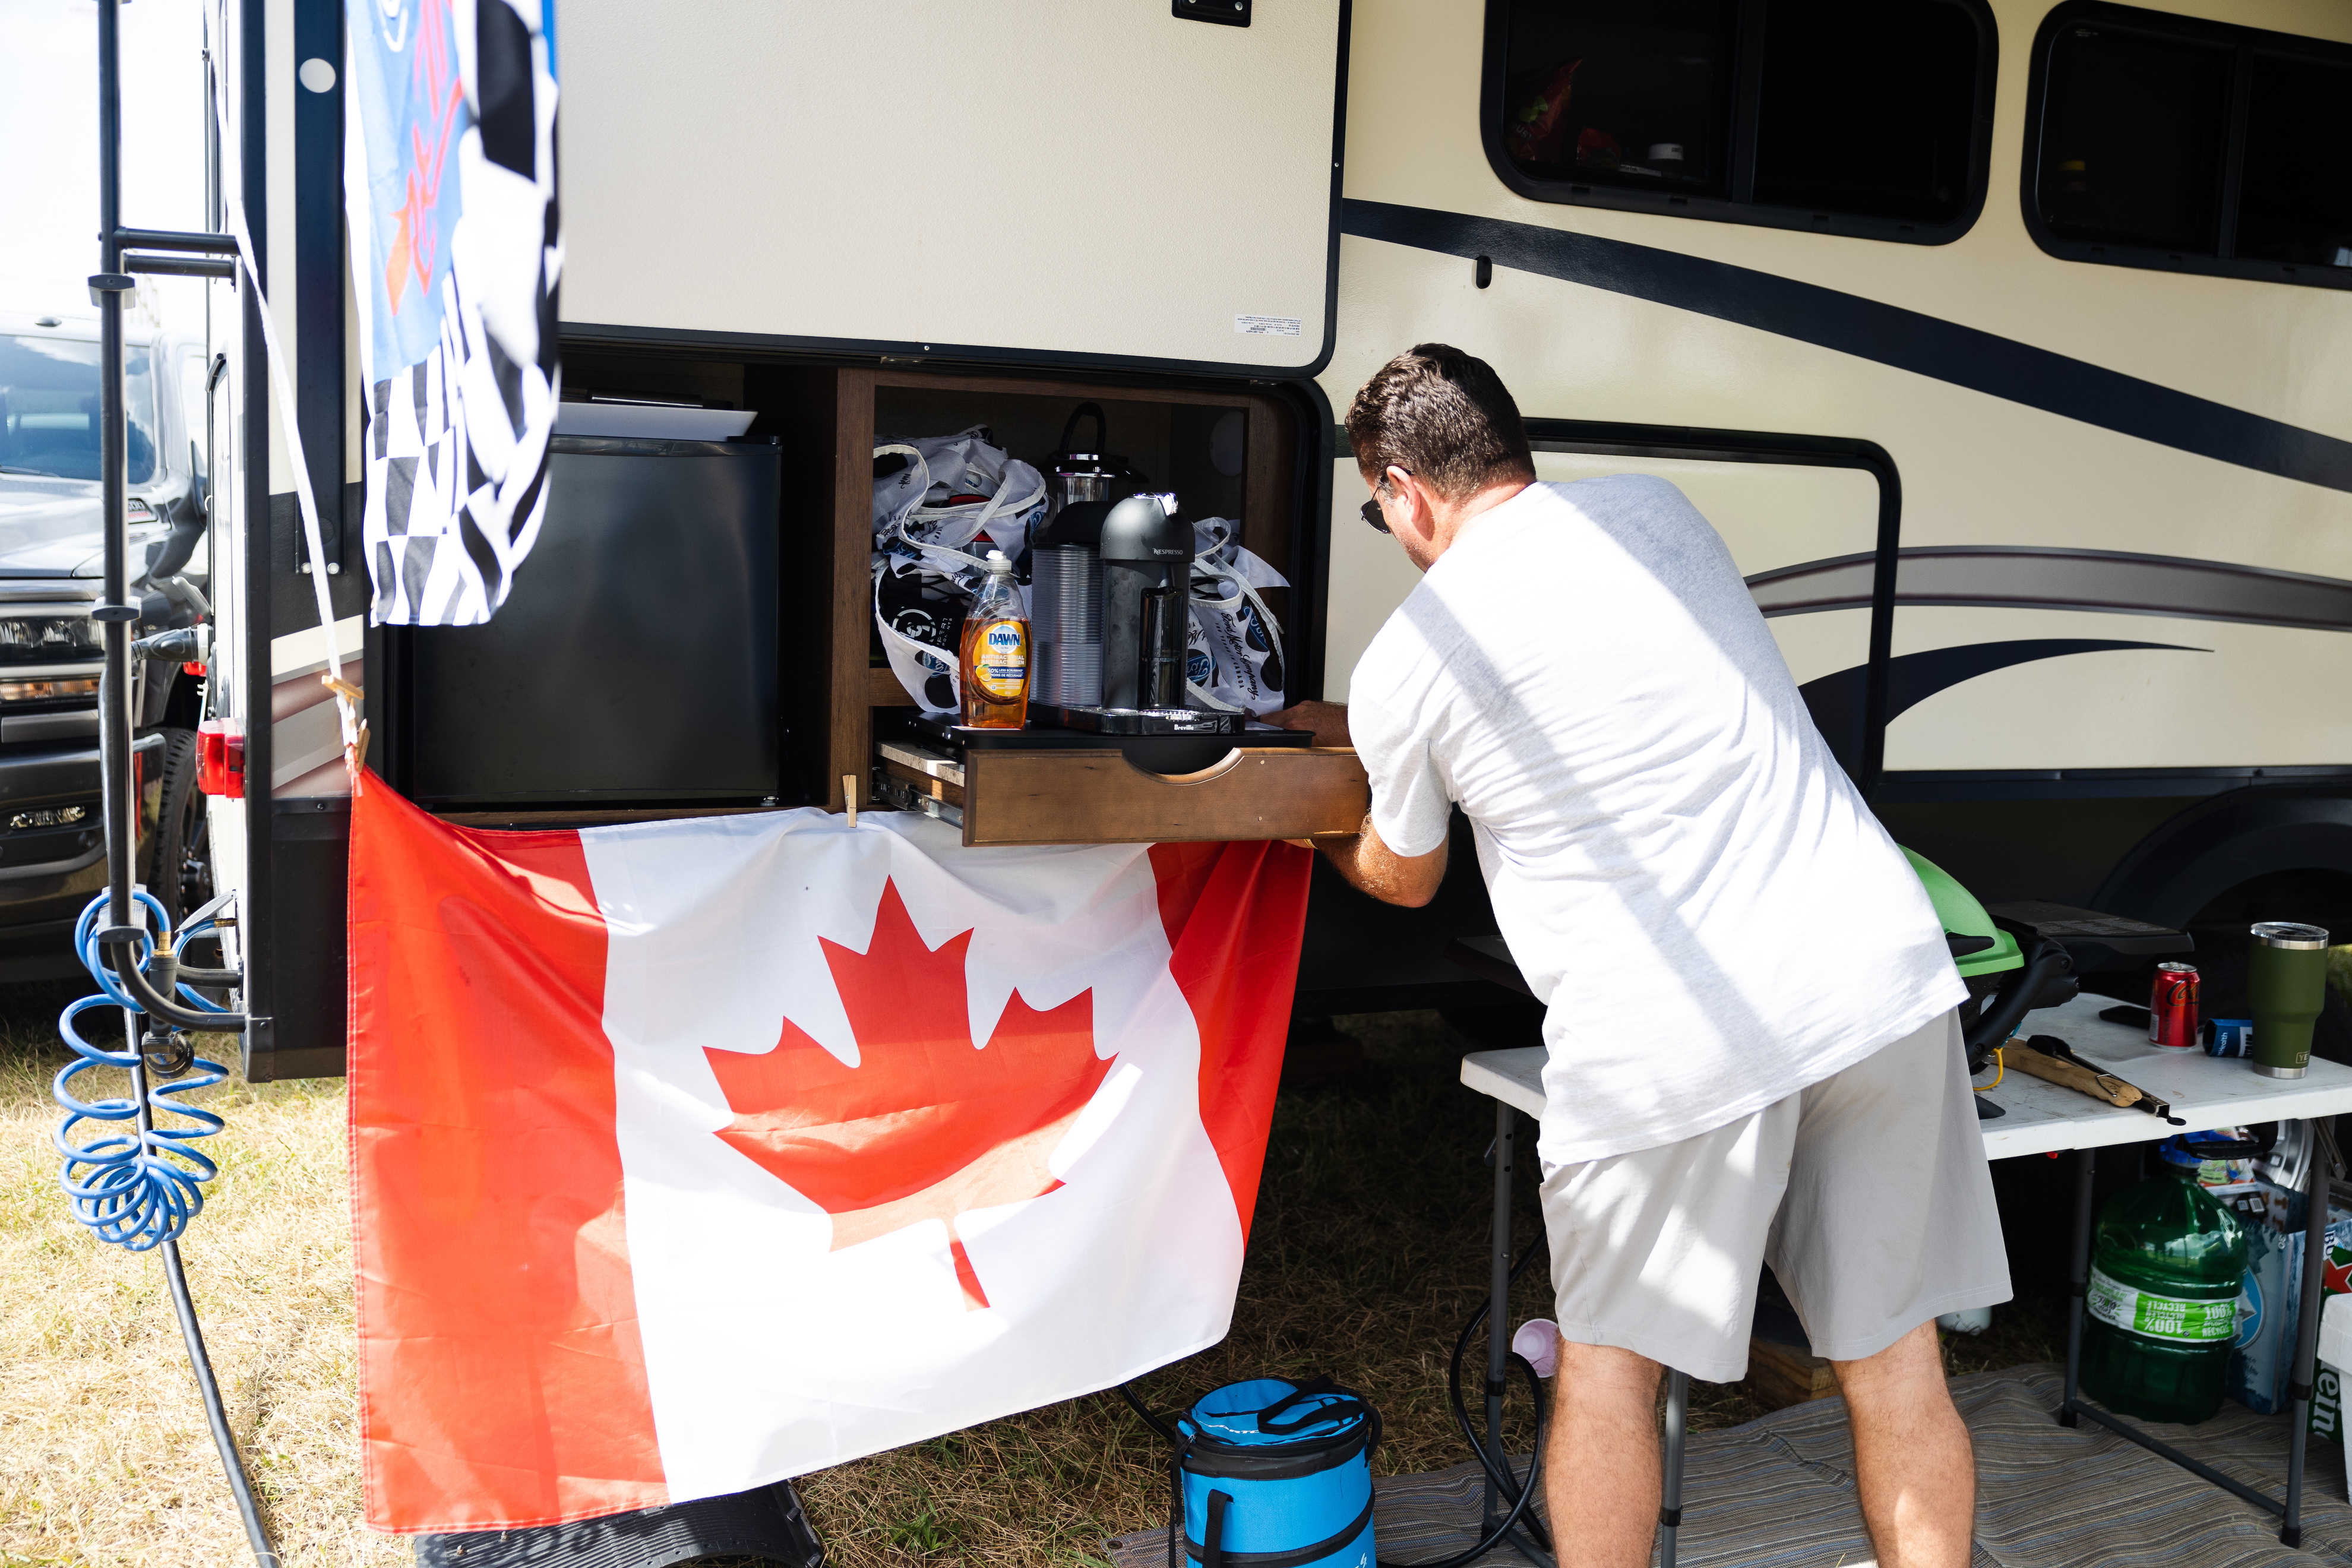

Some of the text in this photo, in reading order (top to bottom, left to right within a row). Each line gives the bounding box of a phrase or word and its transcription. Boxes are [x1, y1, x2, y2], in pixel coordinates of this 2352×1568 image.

[1221, 612, 1236, 634] Ford
[988, 633, 1020, 646] DAWN
[1226, 631, 1243, 656] Motor
[1220, 635, 1231, 653] YEARS
[1234, 662, 1244, 689] CANADA
[1240, 654, 1259, 700] Company
[2204, 1303, 2233, 1320] 100%
[2144, 1317, 2184, 1335] 100%
